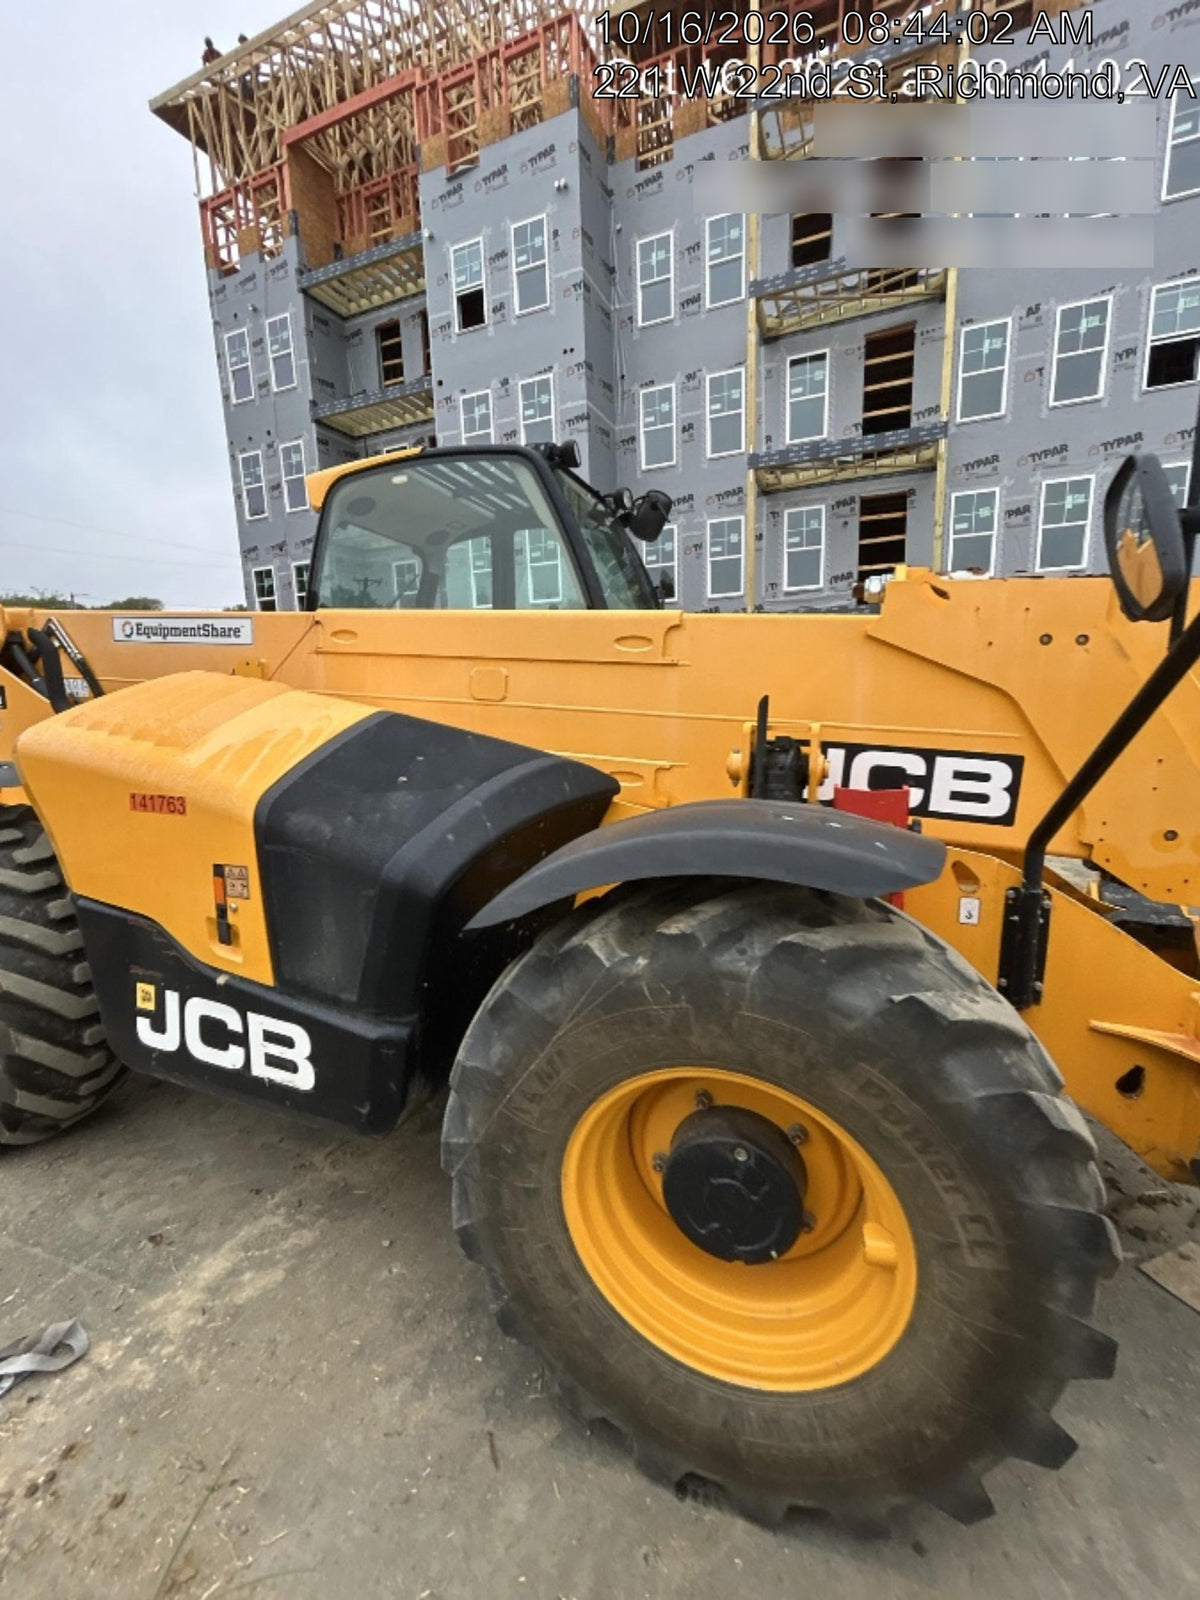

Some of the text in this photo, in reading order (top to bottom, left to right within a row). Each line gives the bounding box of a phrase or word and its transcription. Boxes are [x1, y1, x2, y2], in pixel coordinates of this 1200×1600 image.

[528, 143, 556, 168] TYPAR
[482, 163, 508, 186] TYPAR
[635, 170, 664, 193] TYPAR
[438, 182, 464, 203] TYPAR
[1100, 431, 1144, 452] TYPAR
[962, 454, 1000, 472] TYPAR
[1029, 443, 1069, 463] TYPAR
[715, 486, 744, 502] TYPAR
[135, 622, 241, 640] EquipmentShare
[801, 748, 1013, 818] JCB
[130, 792, 187, 815] 141763
[136, 990, 315, 1091] JCB
